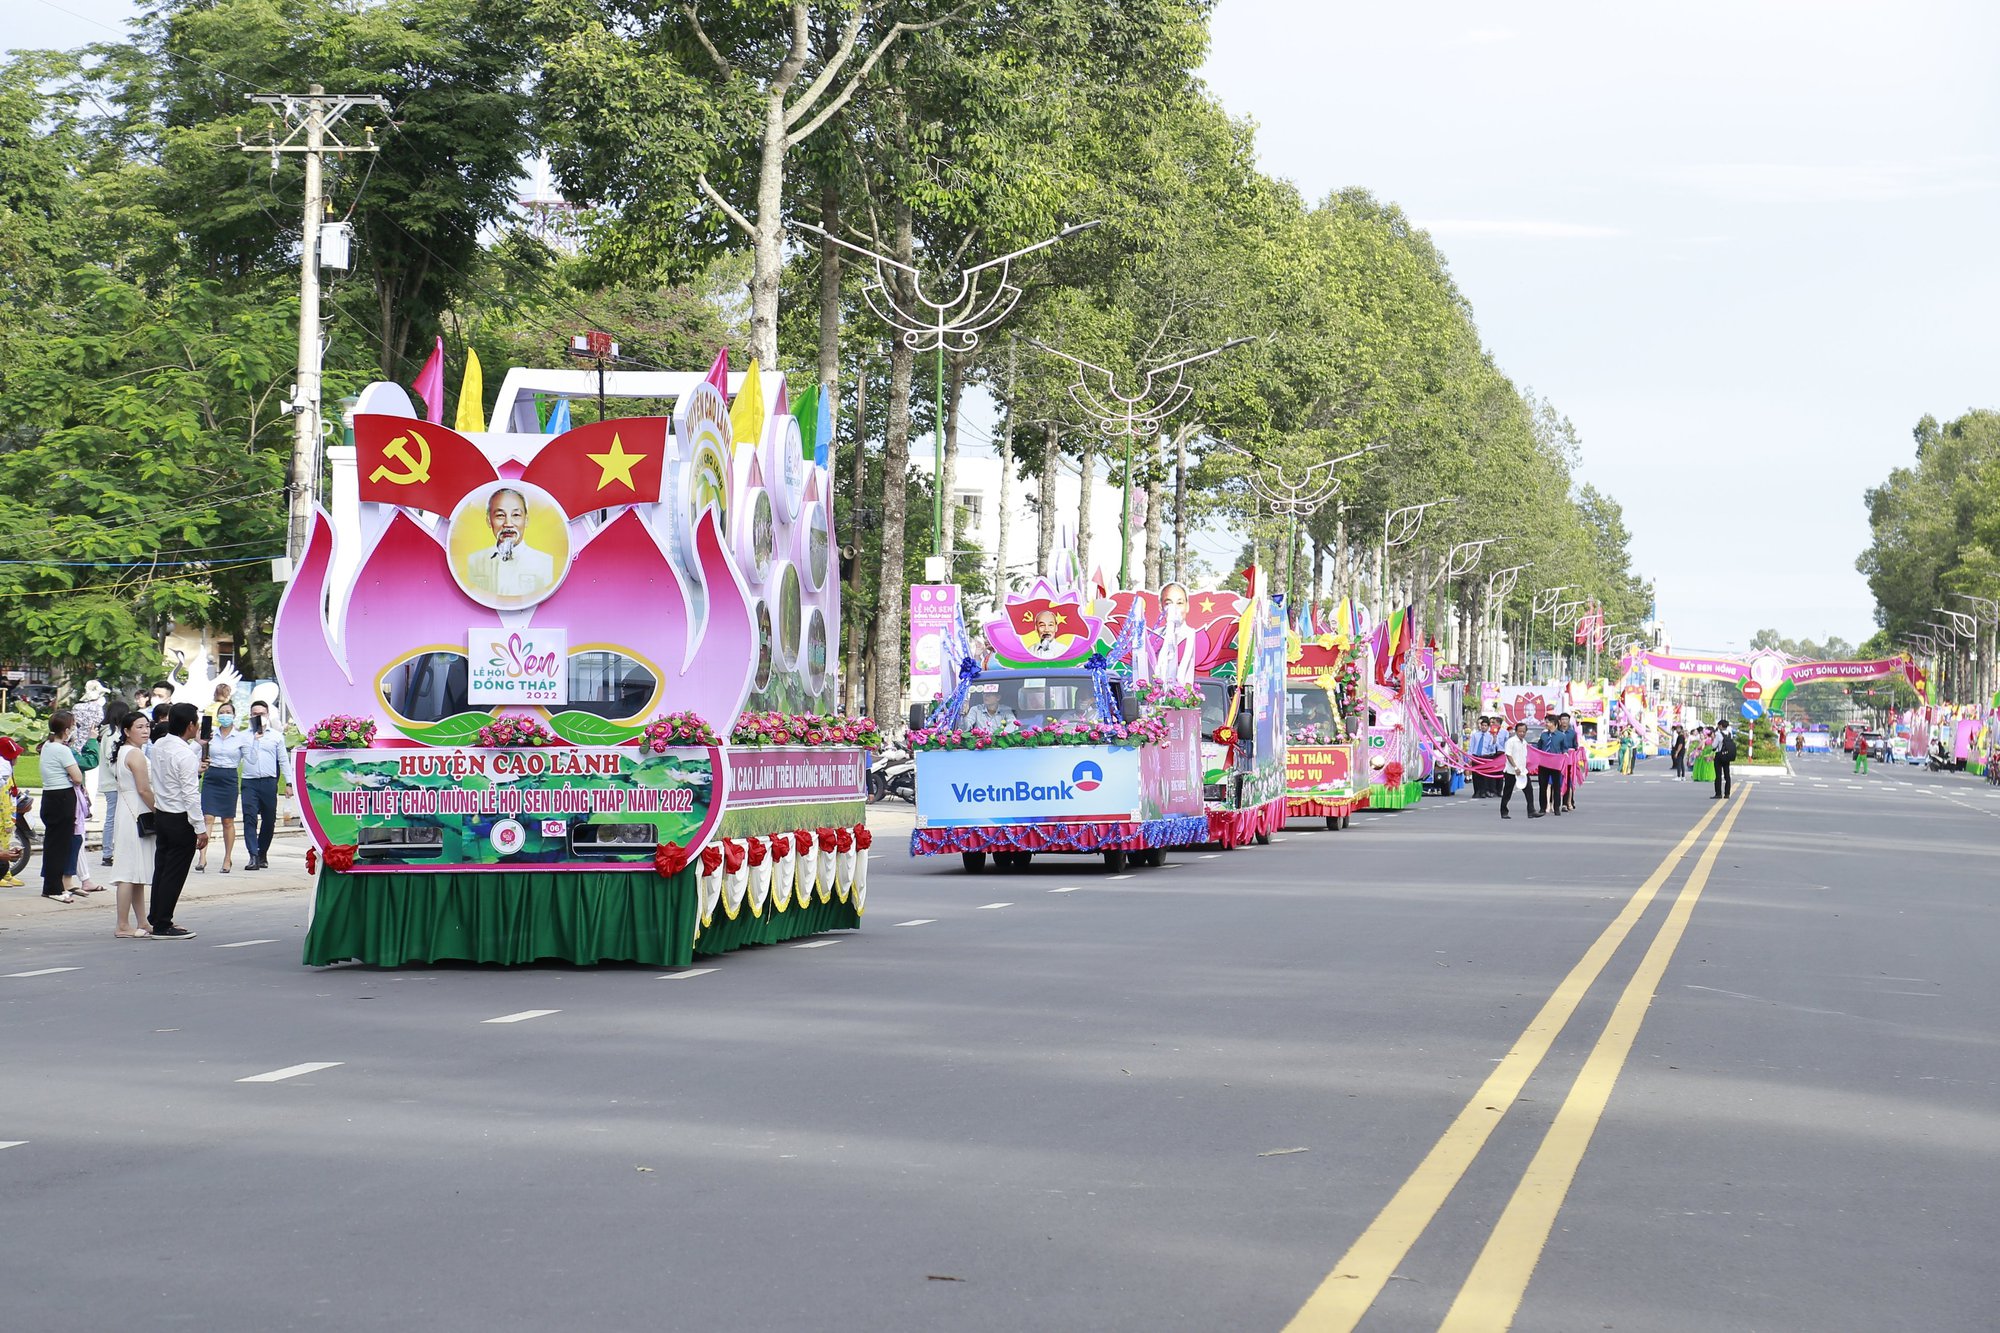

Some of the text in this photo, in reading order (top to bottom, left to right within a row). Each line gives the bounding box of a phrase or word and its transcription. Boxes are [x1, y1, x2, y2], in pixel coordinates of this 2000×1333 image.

[685, 389, 704, 445] HUYỆN
[705, 391, 717, 423] CAO
[507, 632, 559, 678] Sen
[473, 667, 505, 678] LỄ HỘI
[1679, 660, 1694, 671] ĐẤT
[1793, 667, 1814, 679] VƯỢT
[1815, 665, 1838, 675] SÓNG
[1864, 665, 1875, 673] XA
[473, 677, 557, 691] ĐỒNG THÁP
[526, 691, 557, 699] 2022
[399, 749, 621, 780] HUYỆN CAO LÃNH
[1302, 751, 1335, 766] THÂN,
[737, 765, 753, 791] CAO
[754, 759, 774, 790] LÃNH
[776, 760, 794, 788] TRÊN
[796, 758, 818, 788] ĐƯỜNG
[820, 758, 836, 787] PHÁT
[838, 753, 857, 786] TRIỂN
[1308, 769, 1323, 783] VỤ
[951, 780, 1074, 803] VietinBank
[333, 782, 693, 819] NHIỆT LIỆT CHÀO MỪNG LỄ HỘI SEN ĐỒNG THÁP NĂM 2022
